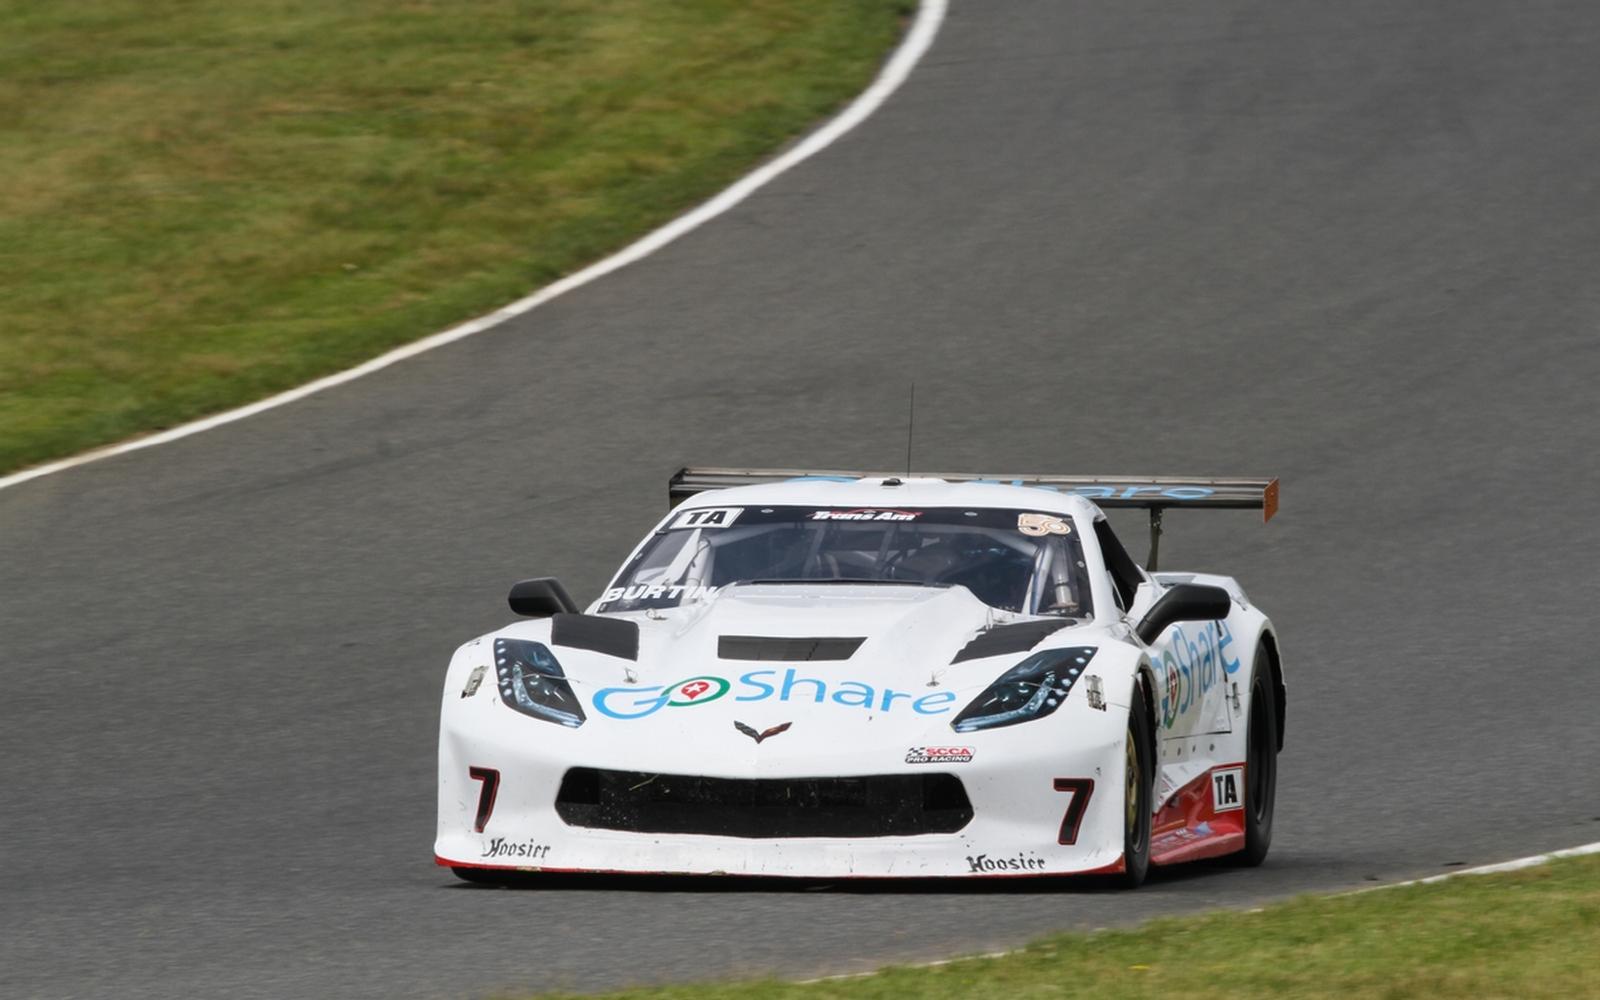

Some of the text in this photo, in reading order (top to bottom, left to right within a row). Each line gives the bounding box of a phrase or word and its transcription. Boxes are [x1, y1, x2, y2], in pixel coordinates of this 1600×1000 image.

[686, 511, 727, 525] TA
[812, 511, 916, 520] Trans Am
[603, 585, 718, 603] BURTIN
[906, 755, 928, 763] PRO
[1215, 774, 1237, 805] TA
[469, 766, 500, 833] 7
[1053, 778, 1095, 845] 7
